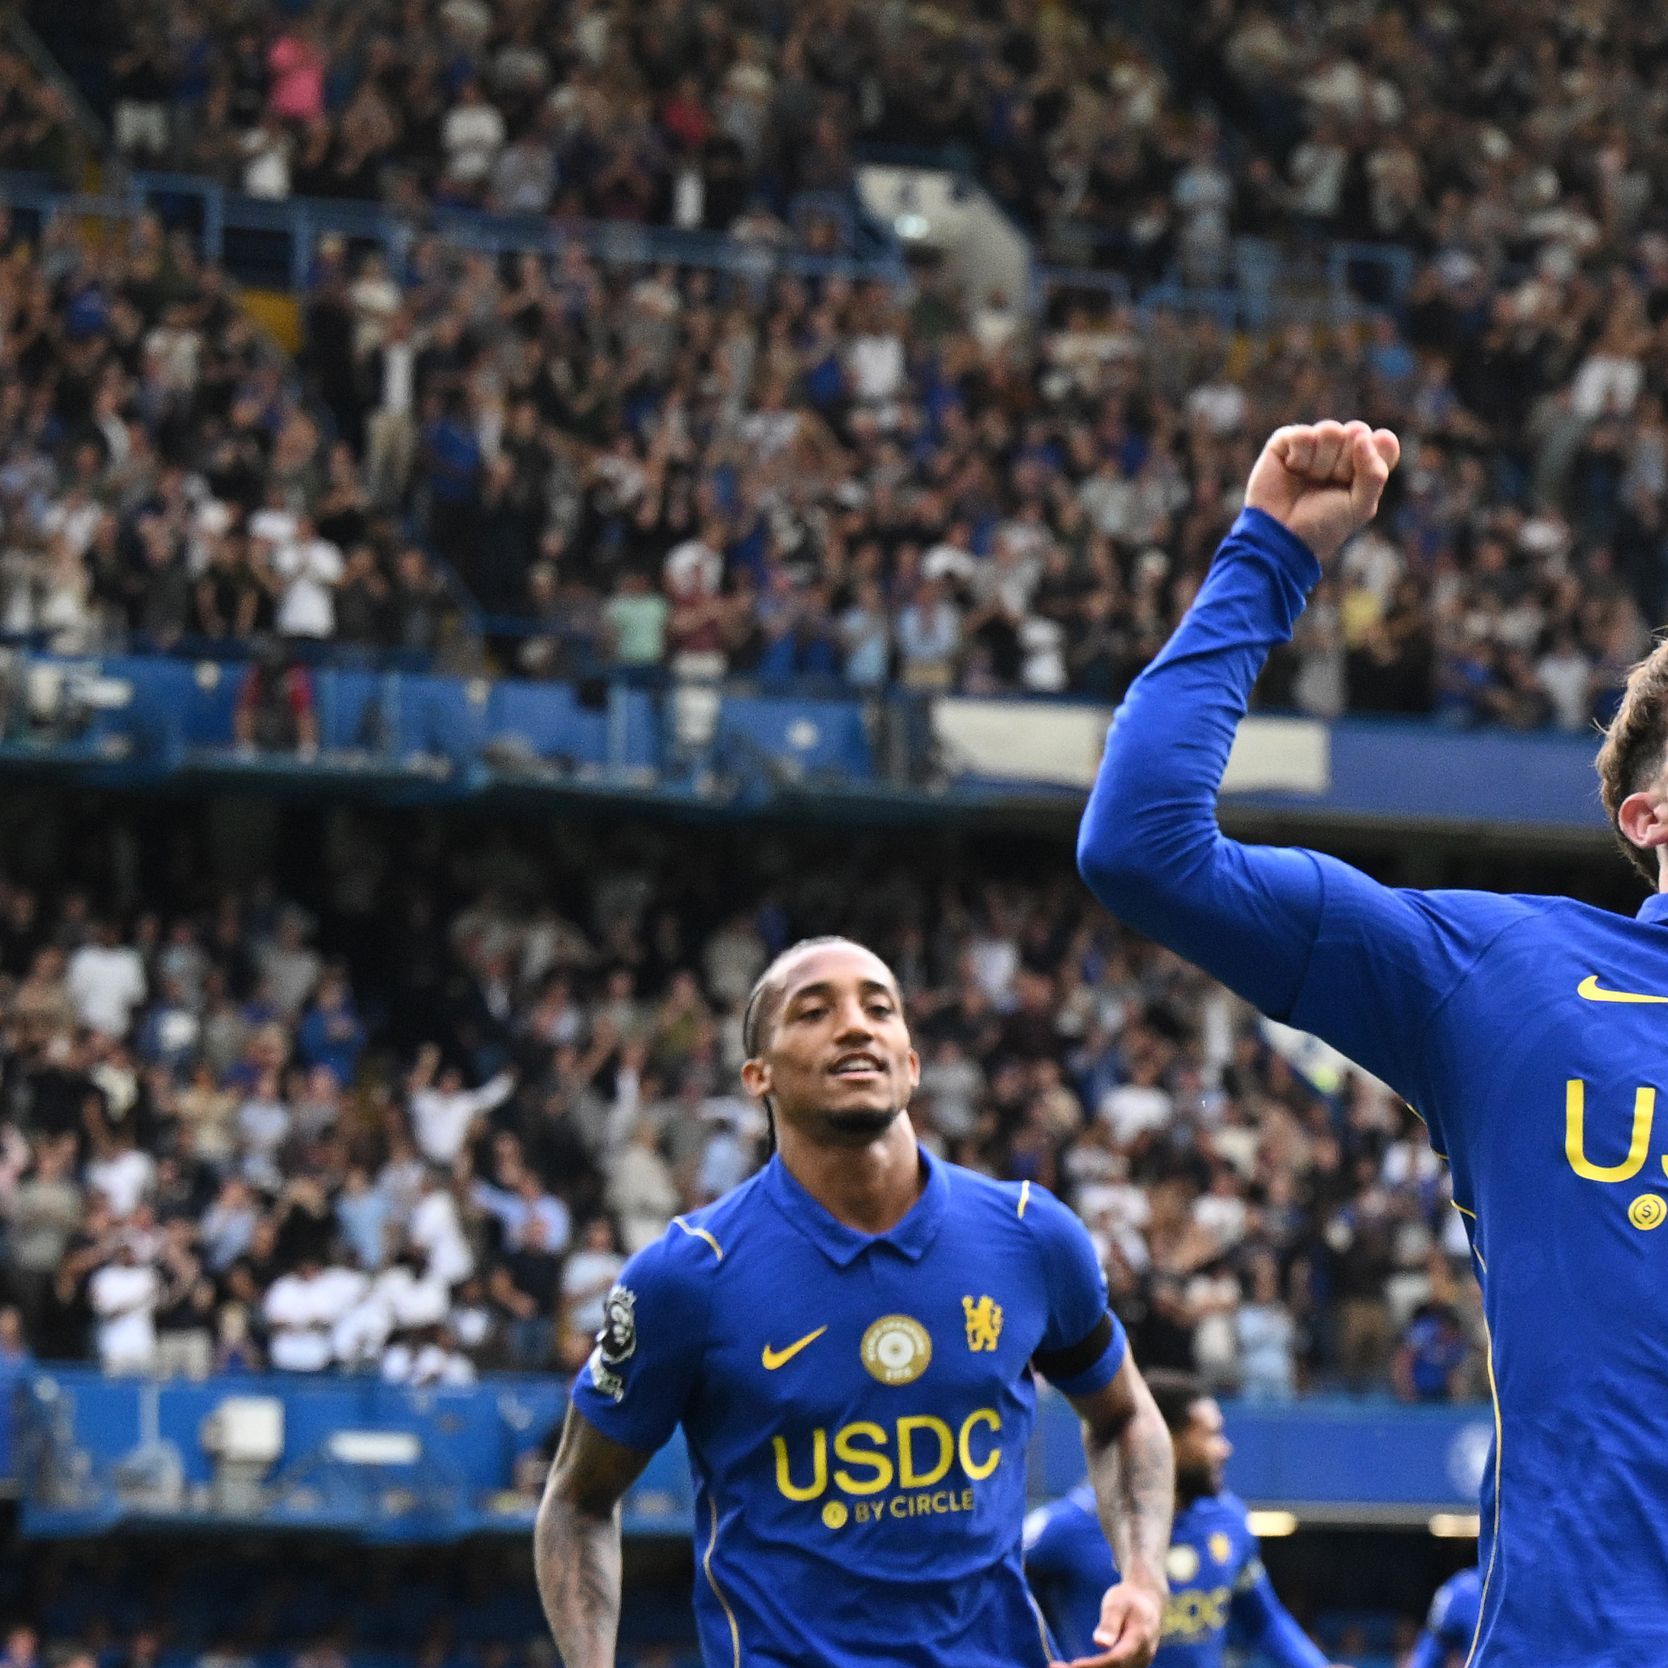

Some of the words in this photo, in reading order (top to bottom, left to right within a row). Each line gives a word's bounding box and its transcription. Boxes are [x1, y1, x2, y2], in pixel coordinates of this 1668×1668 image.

[772, 1408, 1001, 1502] USDC
[854, 1501, 885, 1523] BY
[889, 1488, 975, 1519] CIRCLE
